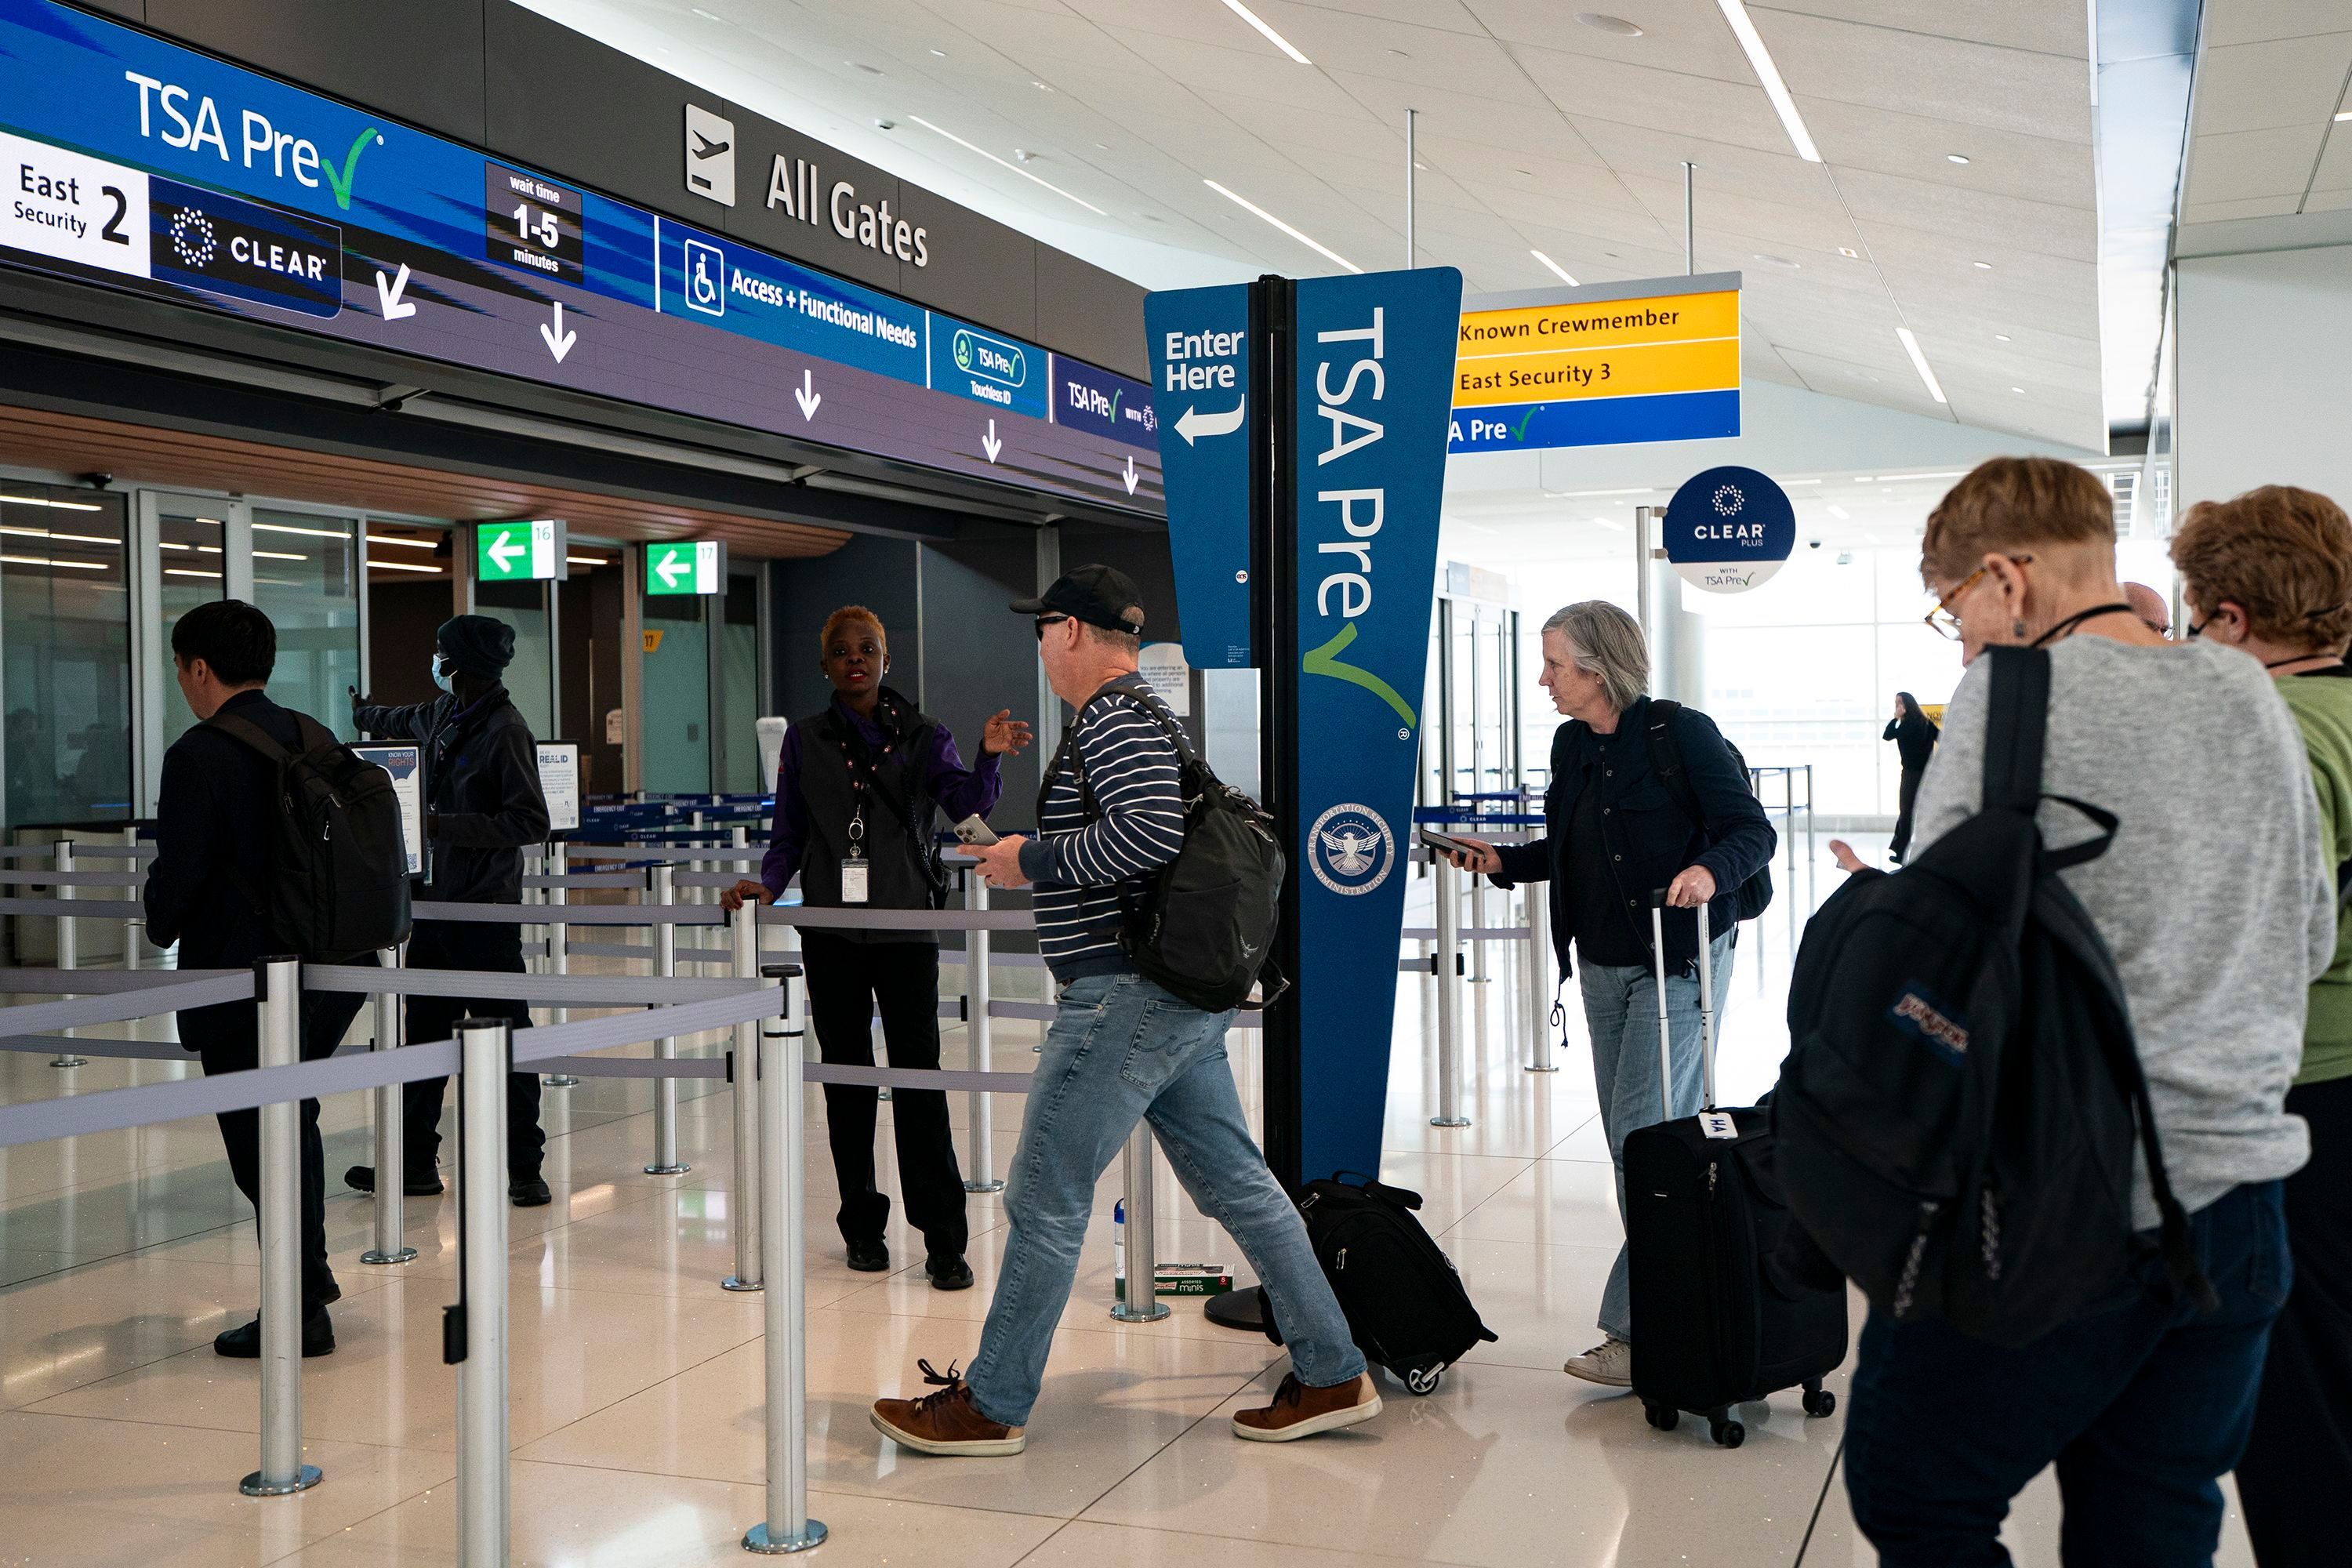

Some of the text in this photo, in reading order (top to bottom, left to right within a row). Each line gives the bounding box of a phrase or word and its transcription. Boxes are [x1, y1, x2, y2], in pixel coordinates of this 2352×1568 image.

[125, 70, 319, 187] TSA Pre
[20, 163, 80, 205] East
[510, 176, 561, 203] wait time
[14, 201, 87, 238] Security
[101, 185, 129, 246] 2
[767, 154, 928, 267] All Gates
[514, 204, 559, 249] 1-5
[230, 236, 323, 281] CLEAR
[514, 249, 559, 272] minutes
[731, 268, 917, 349] Access + Functional Needs
[1461, 309, 1679, 342] Known Crewmember
[1166, 329, 1245, 361] Enter
[978, 347, 1008, 373] TSA Pre
[1166, 363, 1236, 391] Here
[1461, 363, 1611, 390] East Security 3
[971, 380, 1011, 405] Touchless ID
[1068, 381, 1142, 422] TSA Pre WITH
[1471, 419, 1507, 441] Pre
[1316, 307, 1385, 618] TSA Pre
[535, 526, 551, 540] 16
[1694, 524, 1763, 539] CLEAR
[1741, 539, 1763, 547] PLUS
[700, 547, 713, 560] 17
[1704, 576, 1742, 586] TSA Pre
[644, 634, 654, 647] 17
[389, 757, 415, 766] RIGHTS
[539, 755, 560, 764] REAL
[1308, 804, 1394, 895] TRANSPORTATION SECURITY ADMINISTRATION
[1179, 1284, 1203, 1293] minis
